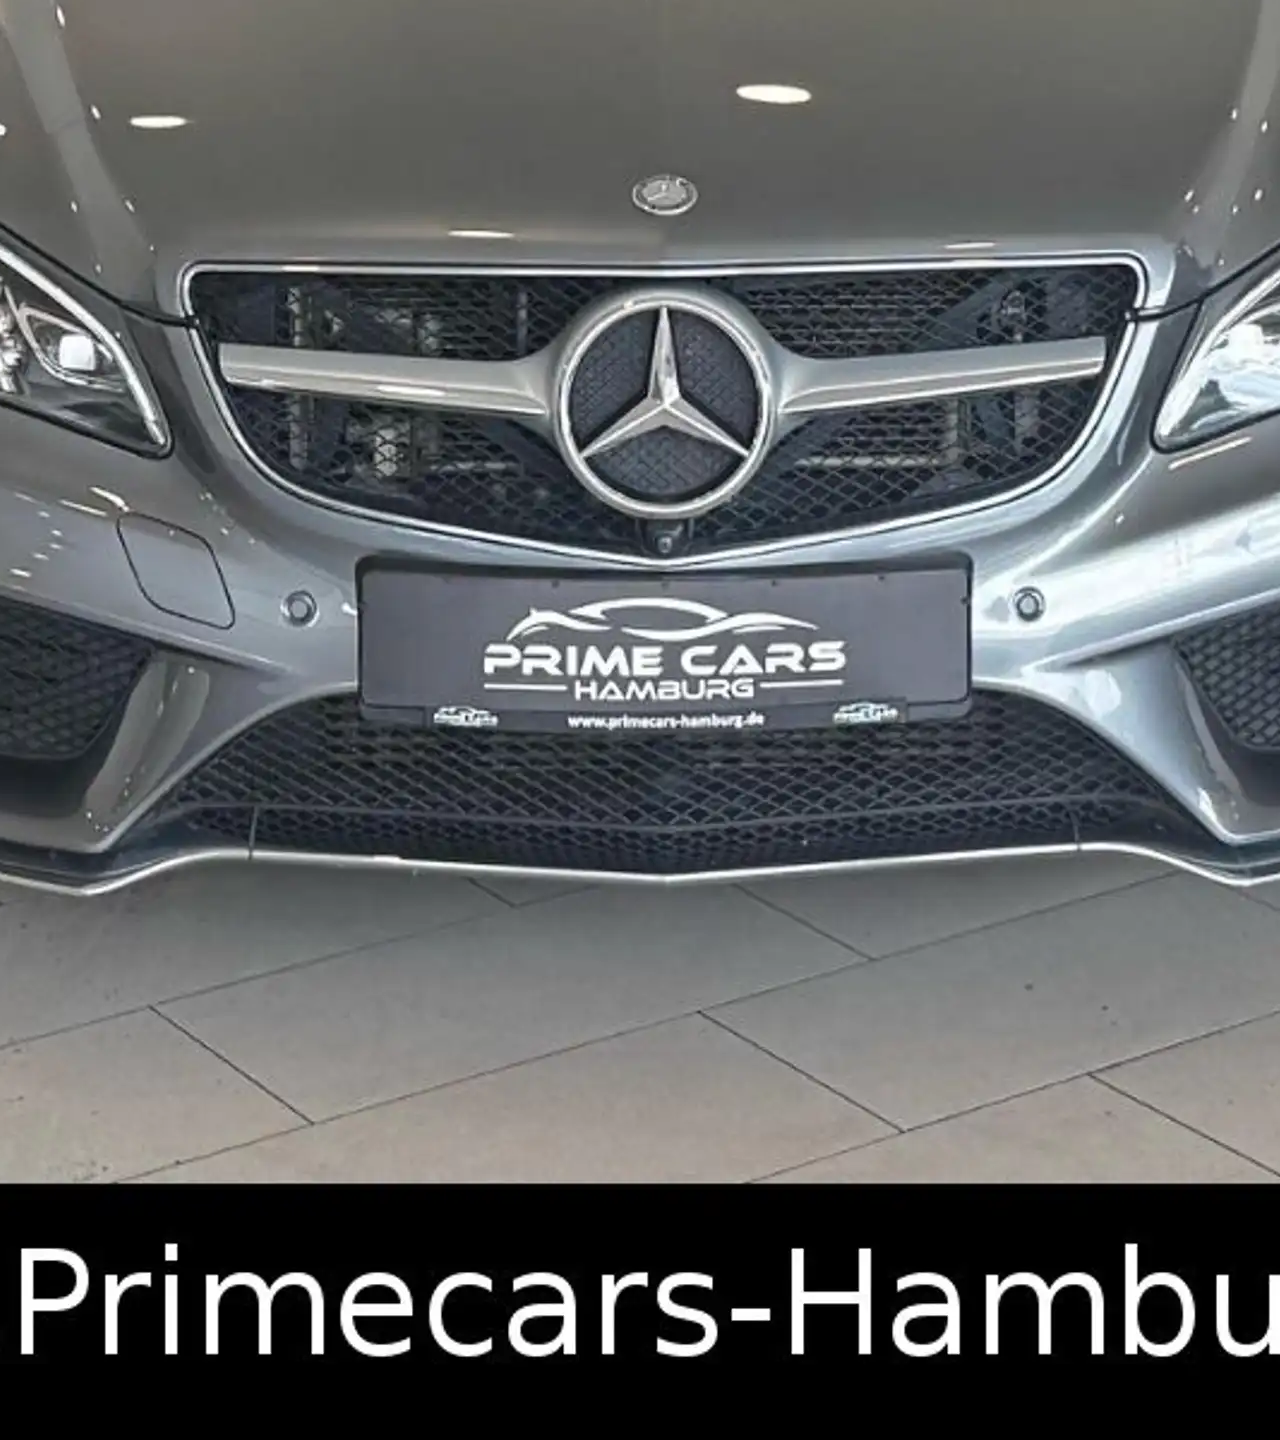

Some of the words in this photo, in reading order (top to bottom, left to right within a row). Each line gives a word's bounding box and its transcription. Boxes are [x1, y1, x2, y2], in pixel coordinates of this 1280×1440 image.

[483, 643, 664, 678] PRIME
[680, 640, 847, 676] CARS
[574, 678, 754, 702] HAMBURG
[568, 711, 764, 731] www.primecars-hamburg.de
